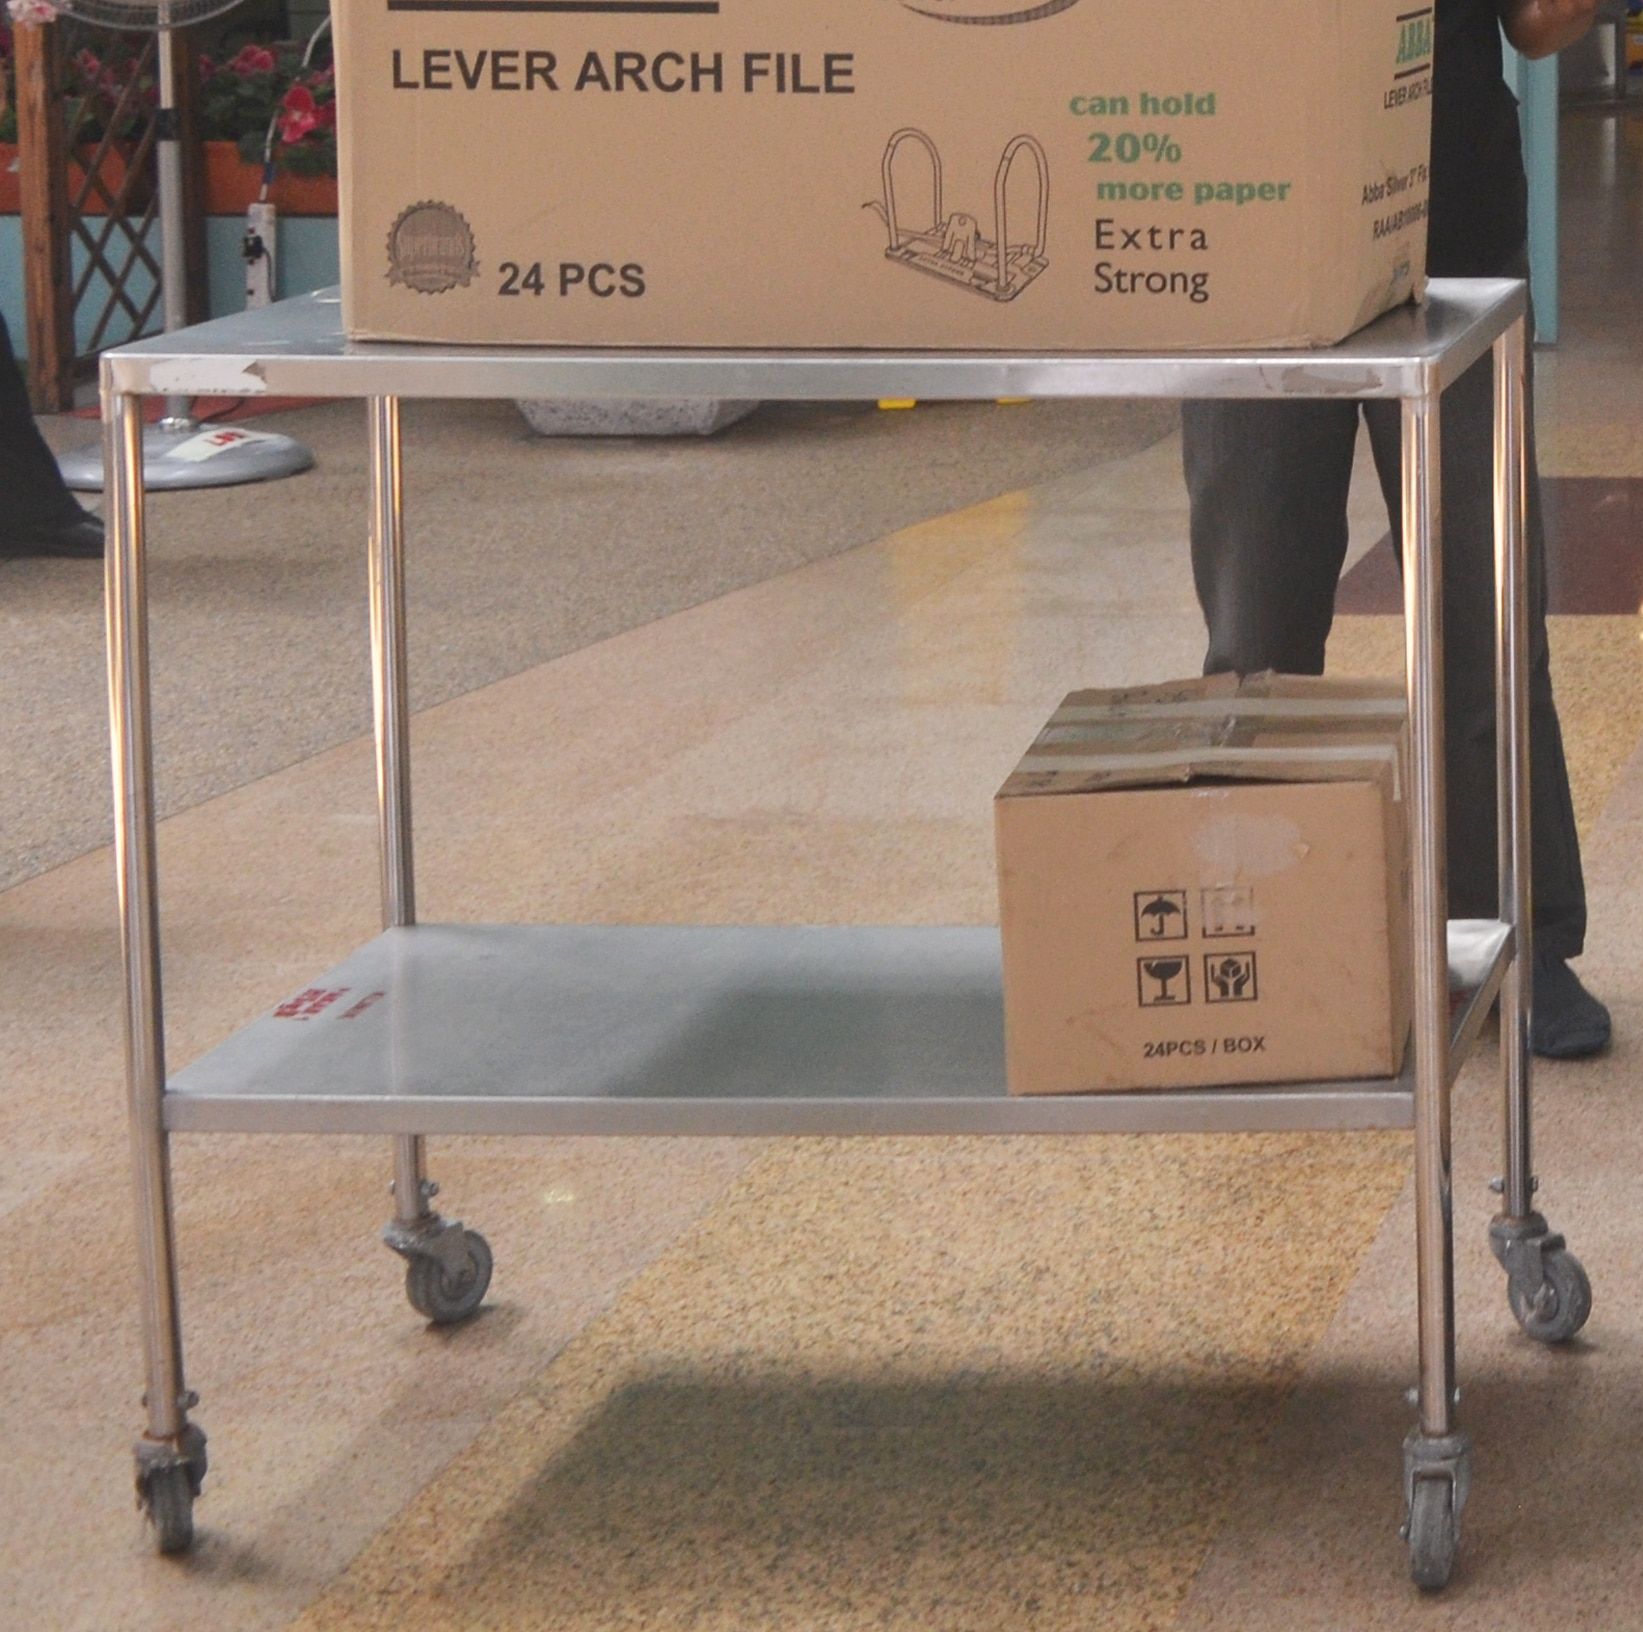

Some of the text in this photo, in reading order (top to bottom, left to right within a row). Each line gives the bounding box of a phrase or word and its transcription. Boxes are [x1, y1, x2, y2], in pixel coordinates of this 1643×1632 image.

[1396, 16, 1433, 65] ABBA
[390, 50, 855, 95] LEVER ARCH FILE
[1069, 91, 1217, 117] can hold
[1087, 133, 1183, 165] 20%
[1096, 178, 1292, 207] more paper
[1094, 218, 1209, 252] Extra
[497, 262, 647, 299] 24 PCS
[1093, 262, 1211, 304] Strong
[1143, 1040, 1207, 1059] 24PCS
[1223, 1037, 1267, 1053] BOX
